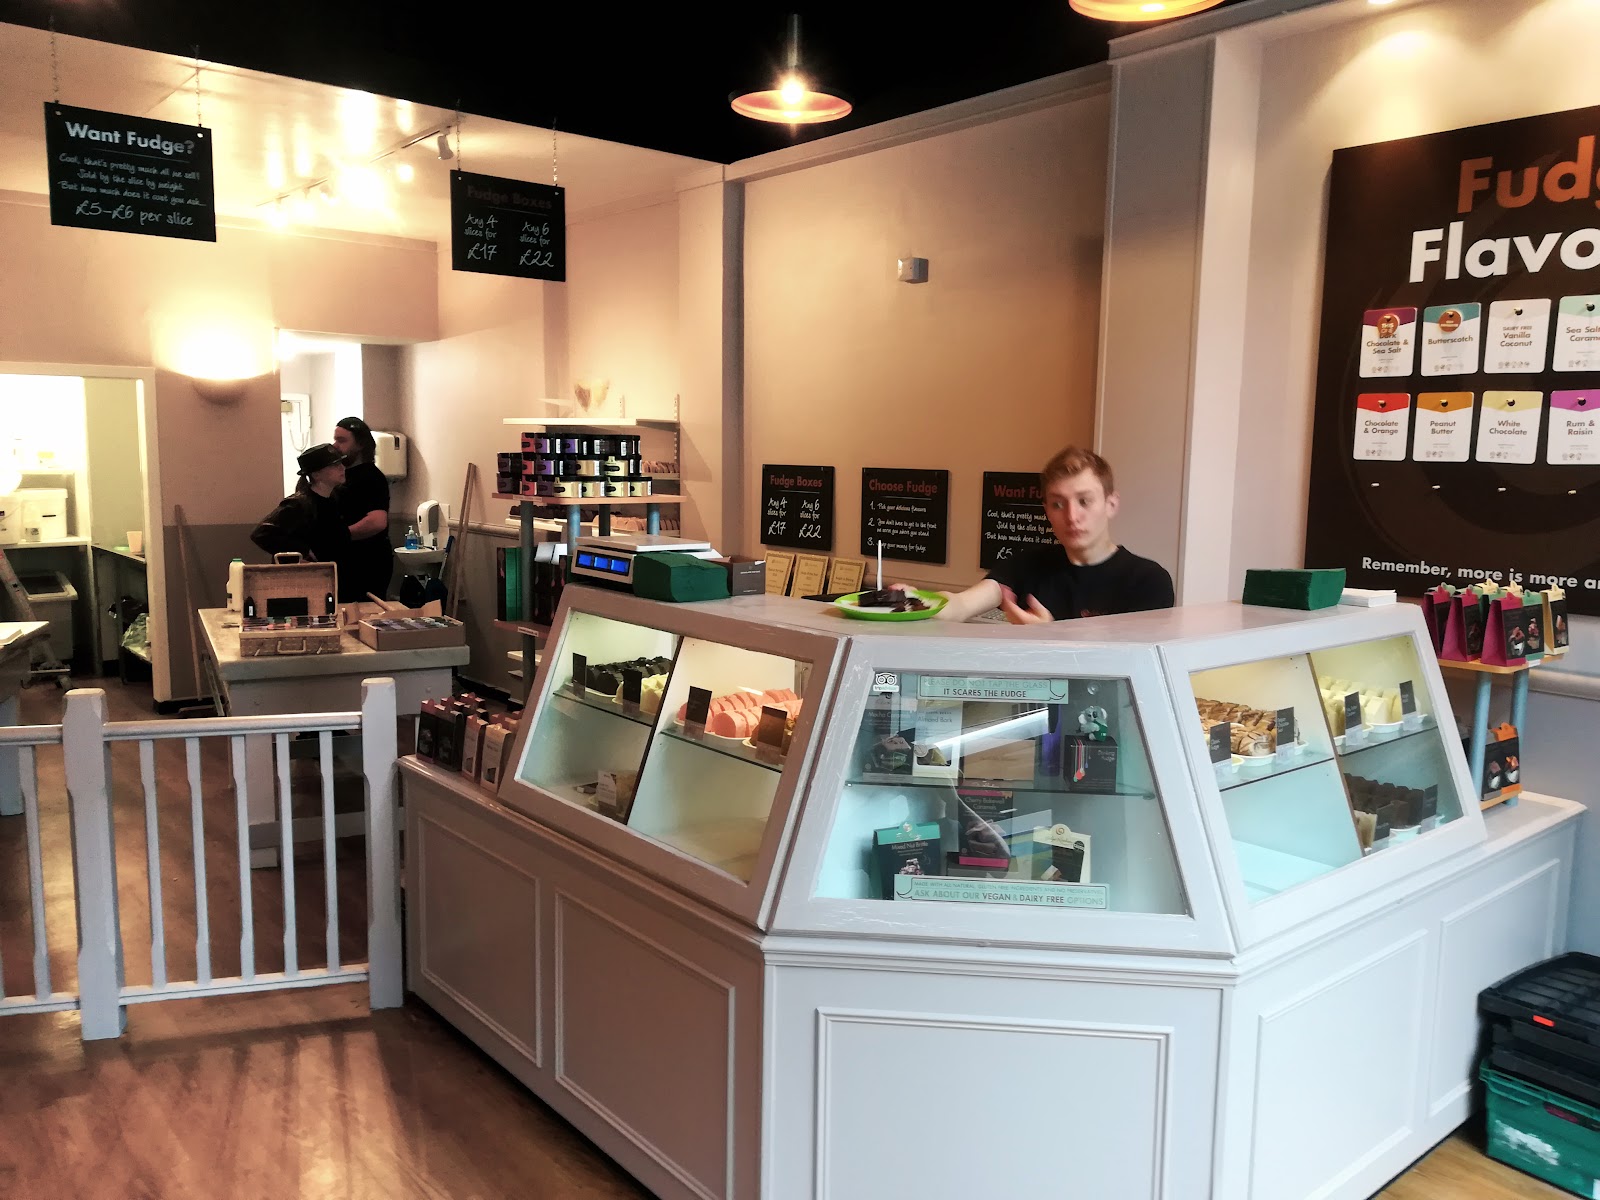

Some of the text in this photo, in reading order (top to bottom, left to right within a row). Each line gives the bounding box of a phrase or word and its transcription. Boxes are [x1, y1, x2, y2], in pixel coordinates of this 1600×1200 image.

[65, 121, 195, 155] Want Fudge?
[110, 162, 135, 174] pretty
[1457, 134, 1600, 214] Fud
[77, 169, 97, 179] Sold
[100, 172, 109, 184] by
[113, 175, 125, 183] the
[128, 177, 144, 185] slice
[146, 178, 155, 190] by
[57, 181, 78, 190] But
[81, 184, 97, 193] how
[123, 189, 141, 198] does
[170, 197, 184, 206] you
[139, 211, 162, 226] per
[167, 212, 193, 226] slice
[465, 213, 498, 228] Any 4
[464, 227, 497, 240] slices for
[522, 222, 550, 236] Any 6
[519, 234, 550, 247] slices for
[467, 243, 497, 260] £17
[519, 249, 554, 268] £22
[1409, 220, 1600, 284] Flavo
[1428, 335, 1474, 345] Butterscotch
[1489, 427, 1527, 435] Chocolate
[770, 474, 823, 488] Fudge Boxes
[869, 479, 938, 496] Choose Fudge
[993, 485, 1025, 498] Want
[768, 496, 788, 509] Any 4
[801, 499, 820, 511] Any 6
[779, 508, 787, 518] for
[812, 511, 820, 521] for
[768, 520, 787, 535] £17
[799, 523, 821, 538] £22
[996, 521, 1008, 530] Sold
[1009, 522, 1015, 532] by
[1017, 523, 1025, 531] the
[1038, 525, 1044, 534] by
[985, 531, 996, 539] But
[1362, 556, 1600, 590] Remember, more is more a
[952, 679, 965, 687] DO
[968, 679, 985, 687] NOT
[986, 680, 1002, 688] TAP
[1004, 680, 1020, 688] THE
[952, 688, 982, 697] SCARES
[984, 689, 999, 697] THE
[1001, 690, 1027, 698] FUDGE
[914, 889, 930, 897] ASK
[932, 890, 960, 898] ABOUT
[962, 891, 980, 899] OUR
[981, 892, 1011, 901] VEGAN
[1019, 894, 1043, 902] DAIRY
[1046, 895, 1064, 903] FREE
[1066, 896, 1104, 905] OPTIONS
